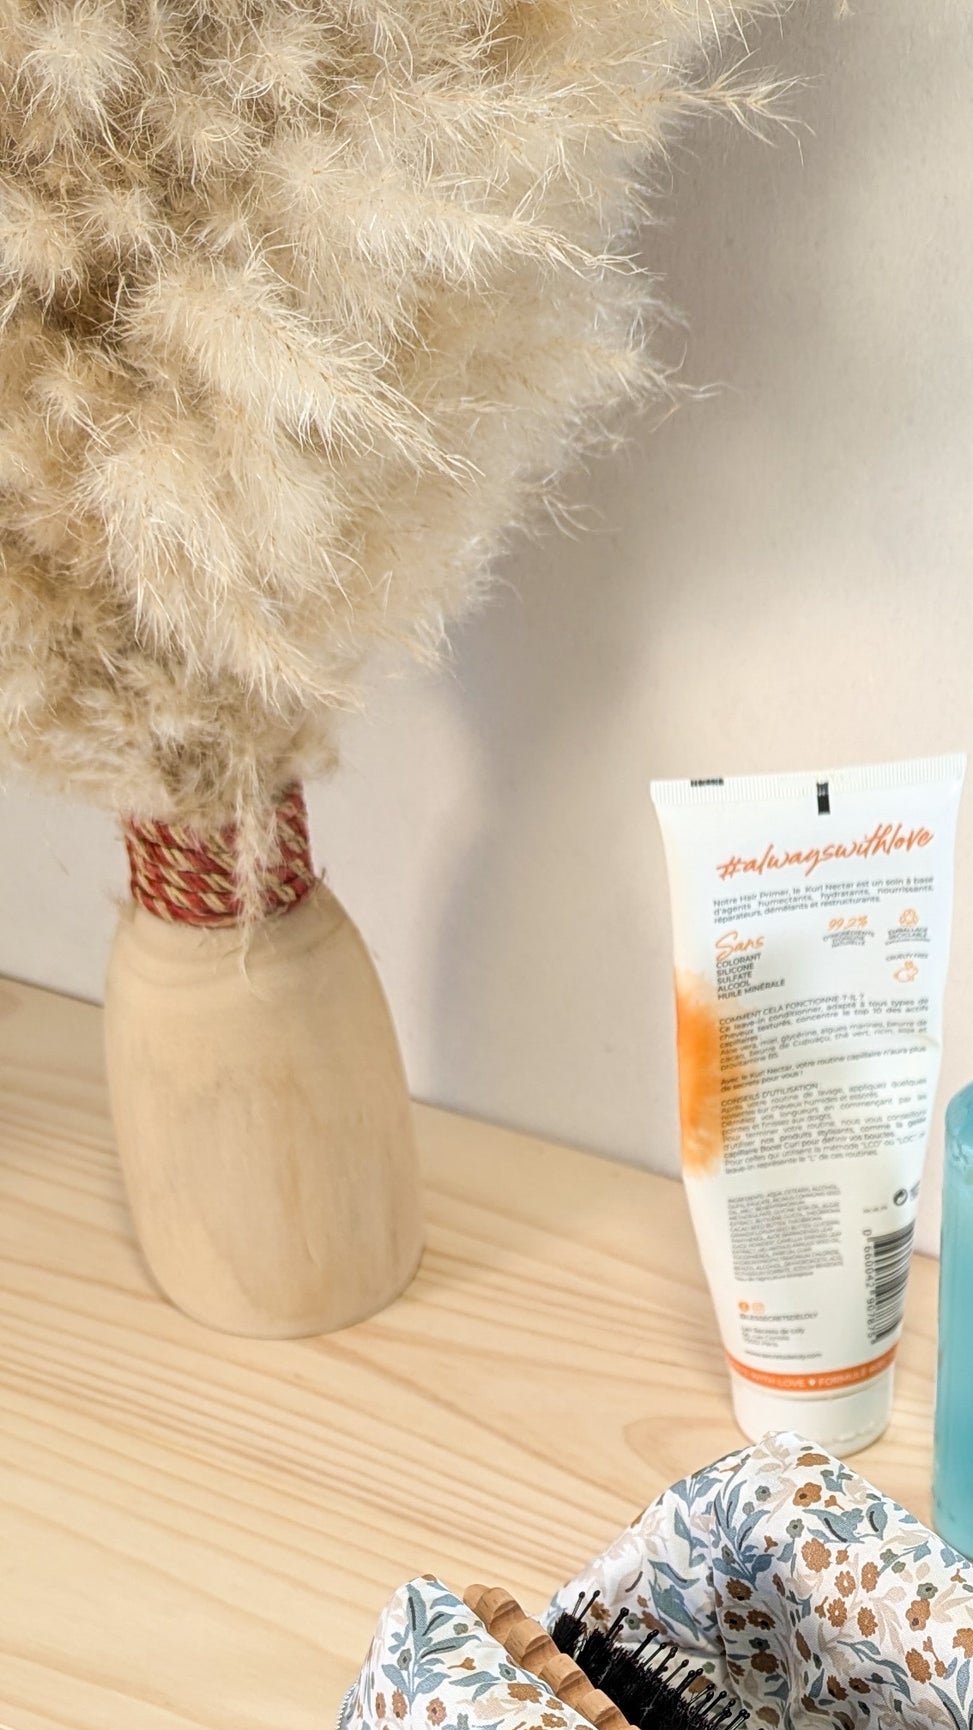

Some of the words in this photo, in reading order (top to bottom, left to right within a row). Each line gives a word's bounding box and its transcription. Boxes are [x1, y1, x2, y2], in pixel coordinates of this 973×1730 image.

[716, 823, 934, 881] #alwayswithlove
[713, 897, 737, 907] Notre
[740, 894, 757, 902] Hair
[825, 883, 854, 891] Nectar
[885, 877, 903, 885] soin
[913, 876, 934, 884] base
[714, 904, 751, 916] d'agents
[716, 931, 765, 961] Sans
[716, 953, 761, 968] COLORANT
[717, 963, 754, 977] SILICONE
[717, 972, 752, 985] SULFATE
[717, 982, 750, 992] ALCOOL
[718, 990, 742, 1000] HUILE
[720, 1010, 761, 1025] COMMENT
[763, 1006, 783, 1015] CELA
[854, 1008, 869, 1016] top
[777, 1377, 806, 1388] LOVE
